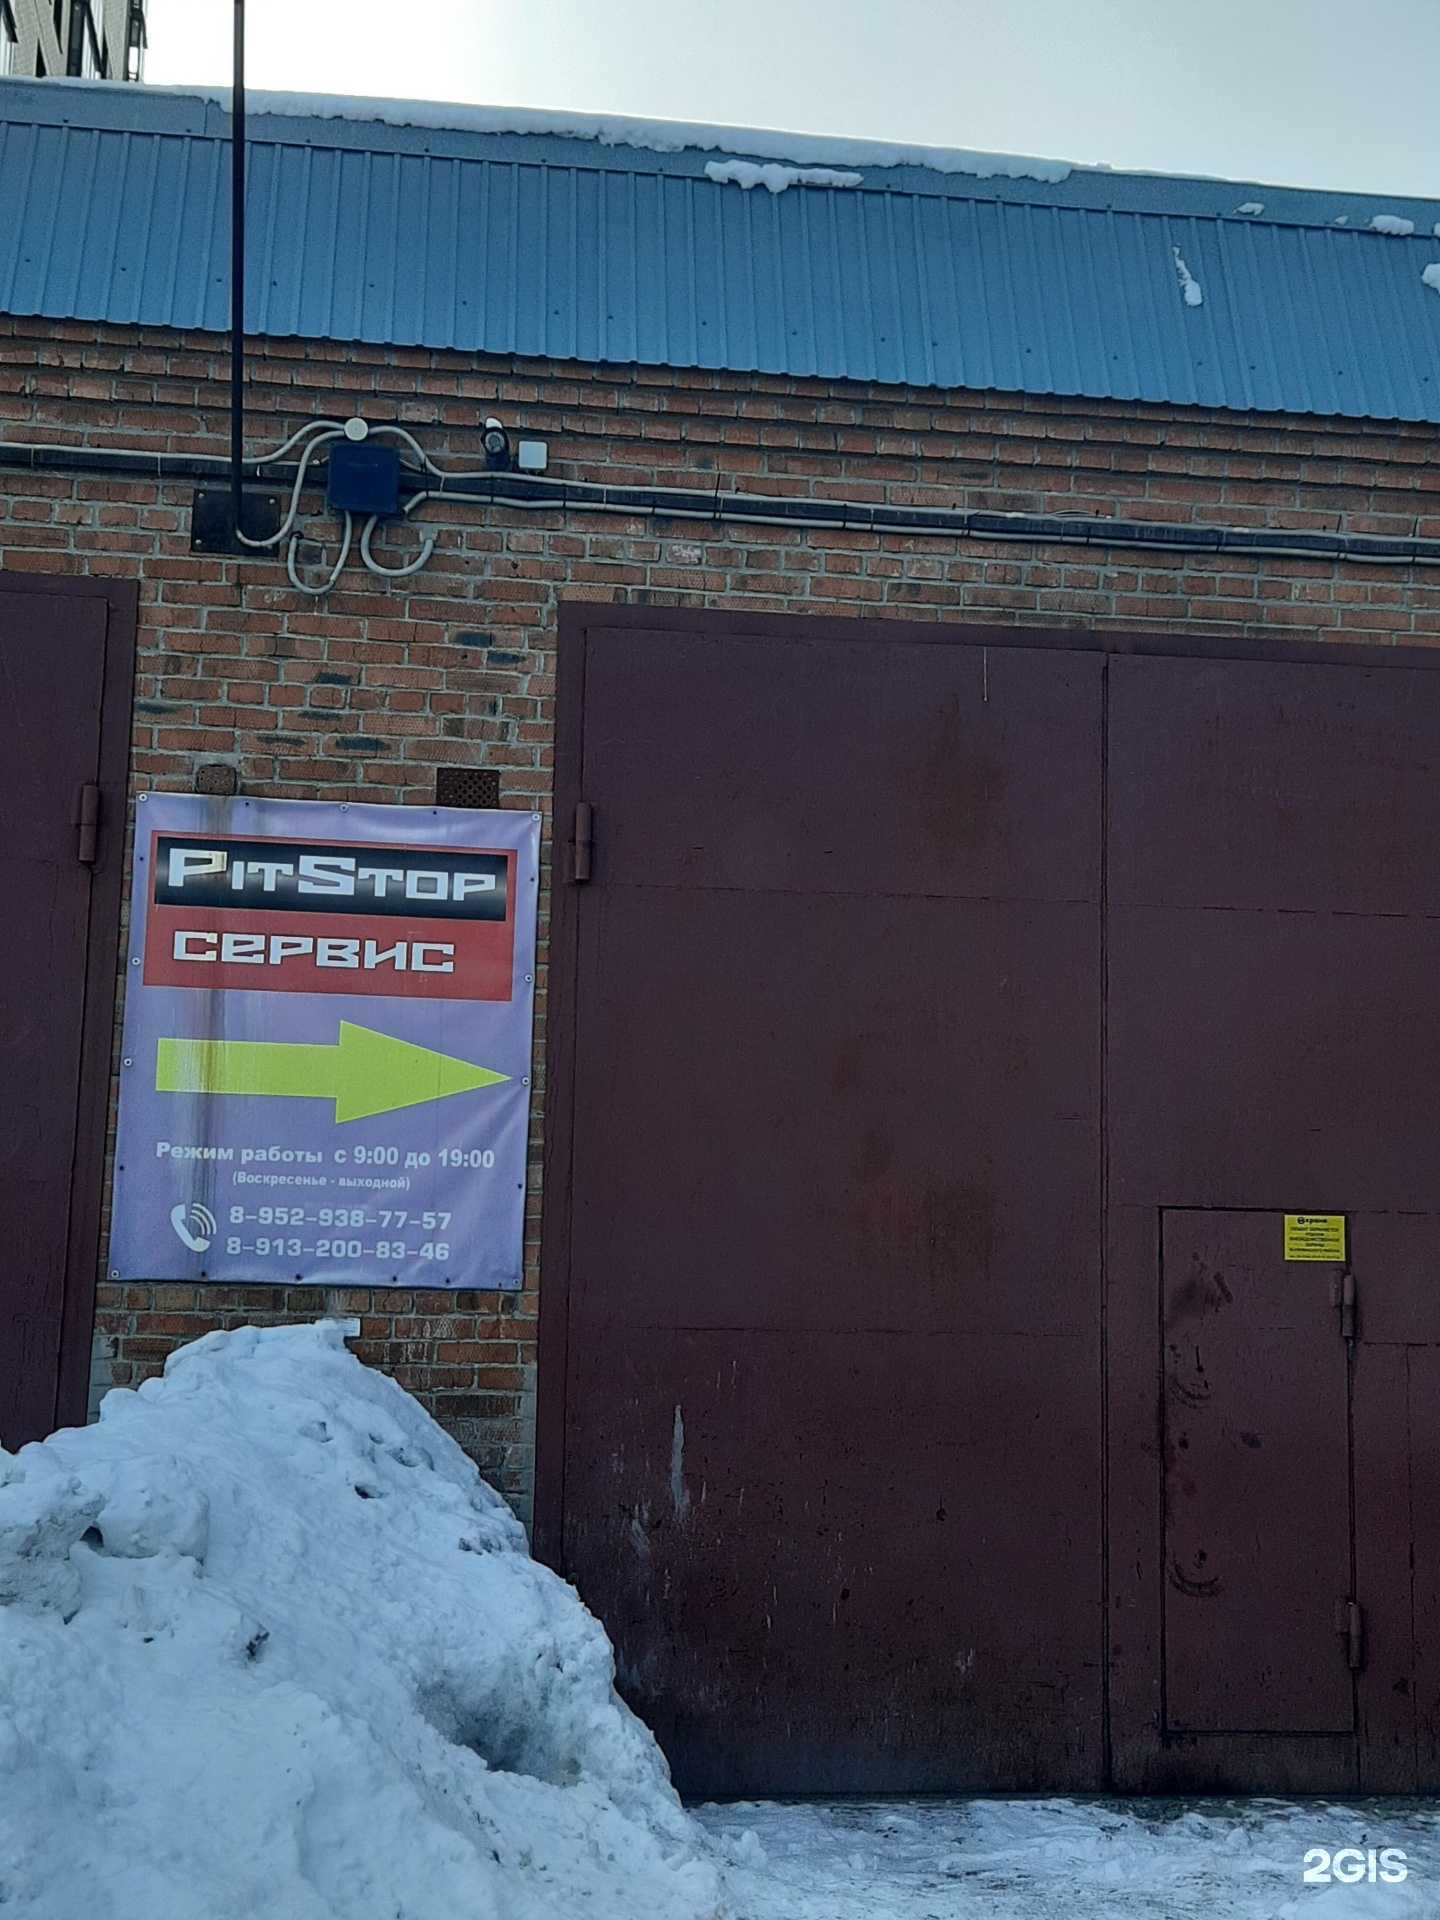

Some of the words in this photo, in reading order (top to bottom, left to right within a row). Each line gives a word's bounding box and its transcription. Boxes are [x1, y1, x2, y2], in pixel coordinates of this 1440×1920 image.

[155, 1142, 234, 1161] Режим
[241, 1145, 323, 1165] работы
[334, 1149, 347, 1164] с
[354, 1145, 399, 1165] 9:00
[404, 1151, 431, 1169] до
[438, 1148, 495, 1169] 19:00
[232, 1170, 328, 1187] (Воскресенье
[338, 1176, 411, 1191] выходной)
[229, 1205, 451, 1231] 8-952-938-77-57
[226, 1236, 450, 1261] 8-913-200-83-46
